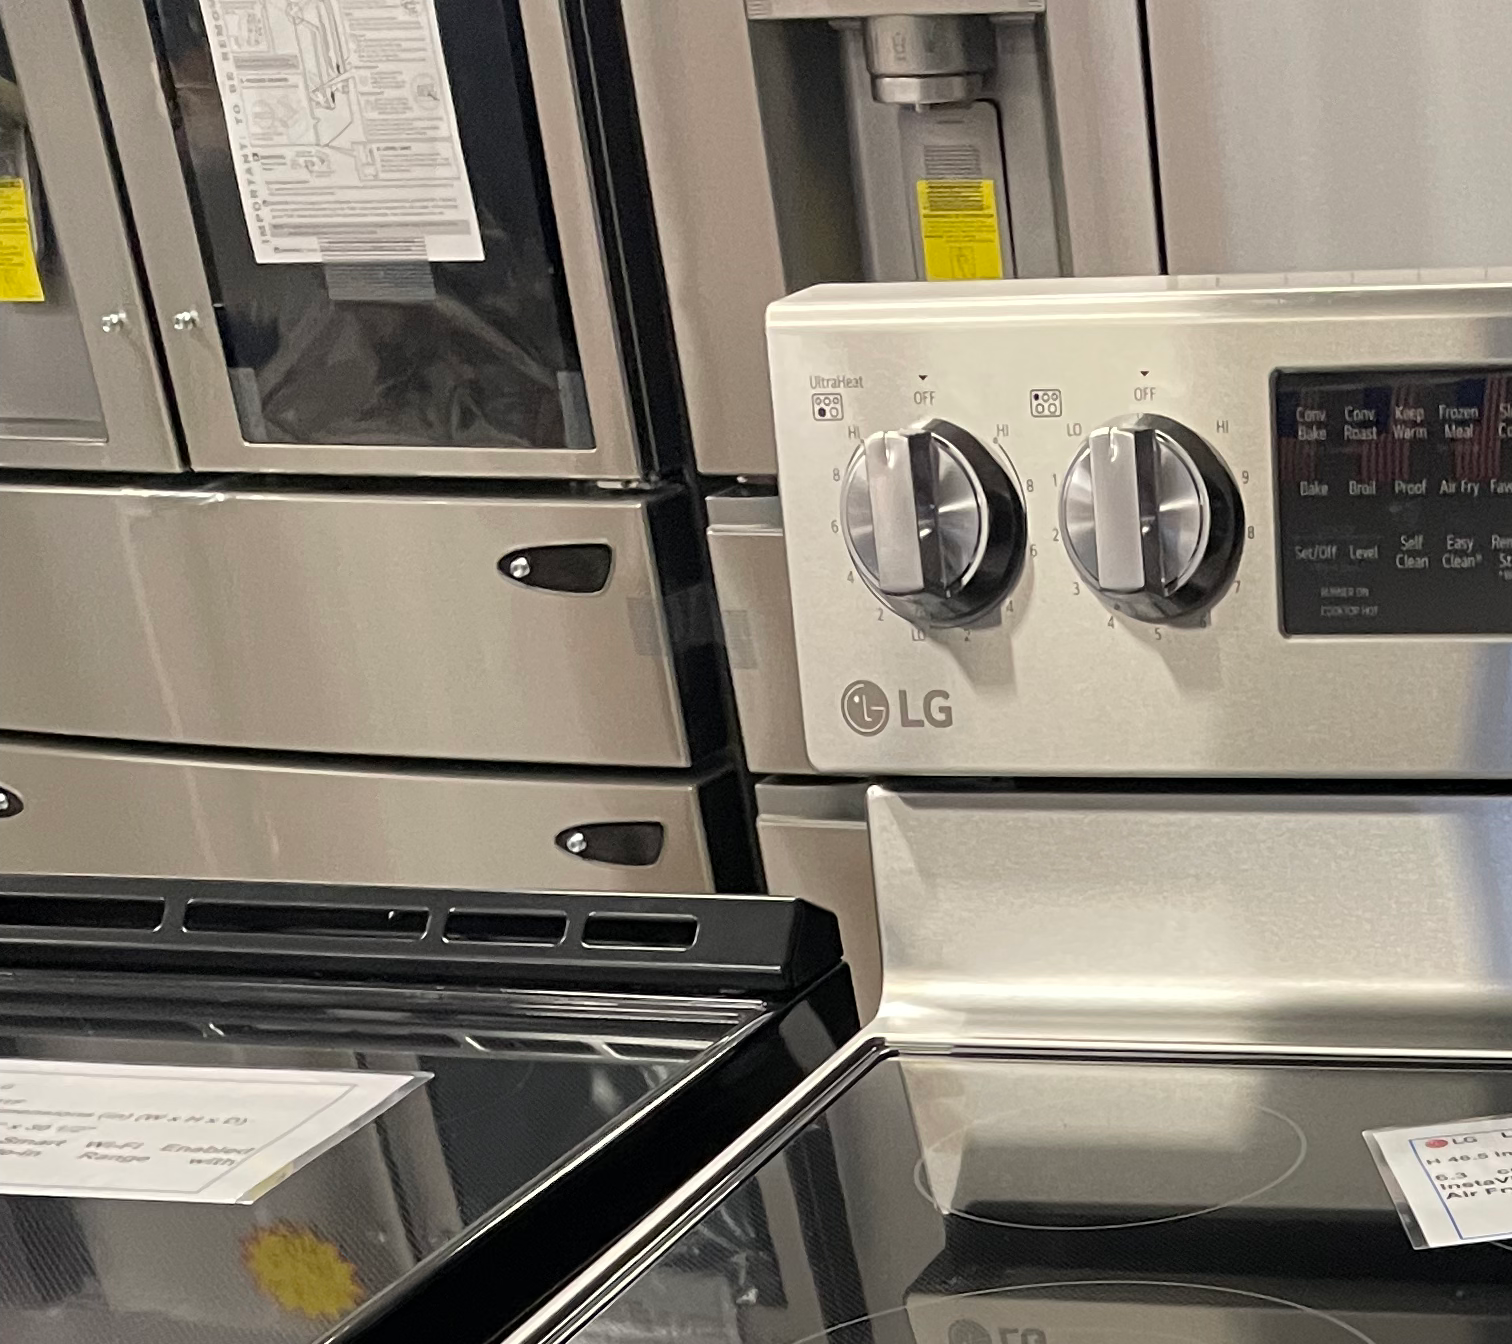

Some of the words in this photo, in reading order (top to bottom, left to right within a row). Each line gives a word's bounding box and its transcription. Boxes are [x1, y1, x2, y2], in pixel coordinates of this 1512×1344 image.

[809, 375, 864, 389] UltraHeat
[914, 391, 936, 405] OFF
[1134, 387, 1156, 402] OFF
[1344, 405, 1376, 421] Conv
[1395, 404, 1425, 423] Keep
[1438, 404, 1479, 420] Frozen
[848, 426, 861, 440] HI
[997, 424, 1009, 437] HI
[1067, 423, 1082, 437] LO
[1216, 420, 1229, 433] HI
[1343, 424, 1378, 440] Roast
[1393, 425, 1428, 440] Warm
[1394, 479, 1427, 495] Proof
[1439, 480, 1456, 495] Air
[1460, 480, 1480, 497] Fry
[1446, 534, 1475, 553] Easy
[1349, 544, 1378, 559] Level
[1395, 554, 1429, 569] Clean
[899, 689, 953, 728] LG
[1452, 1136, 1477, 1146] LG
[77, 1151, 151, 1162] Range
[1426, 1157, 1440, 1166] H
[1435, 1171, 1468, 1182] 6.3
[1446, 1189, 1478, 1201] Air
